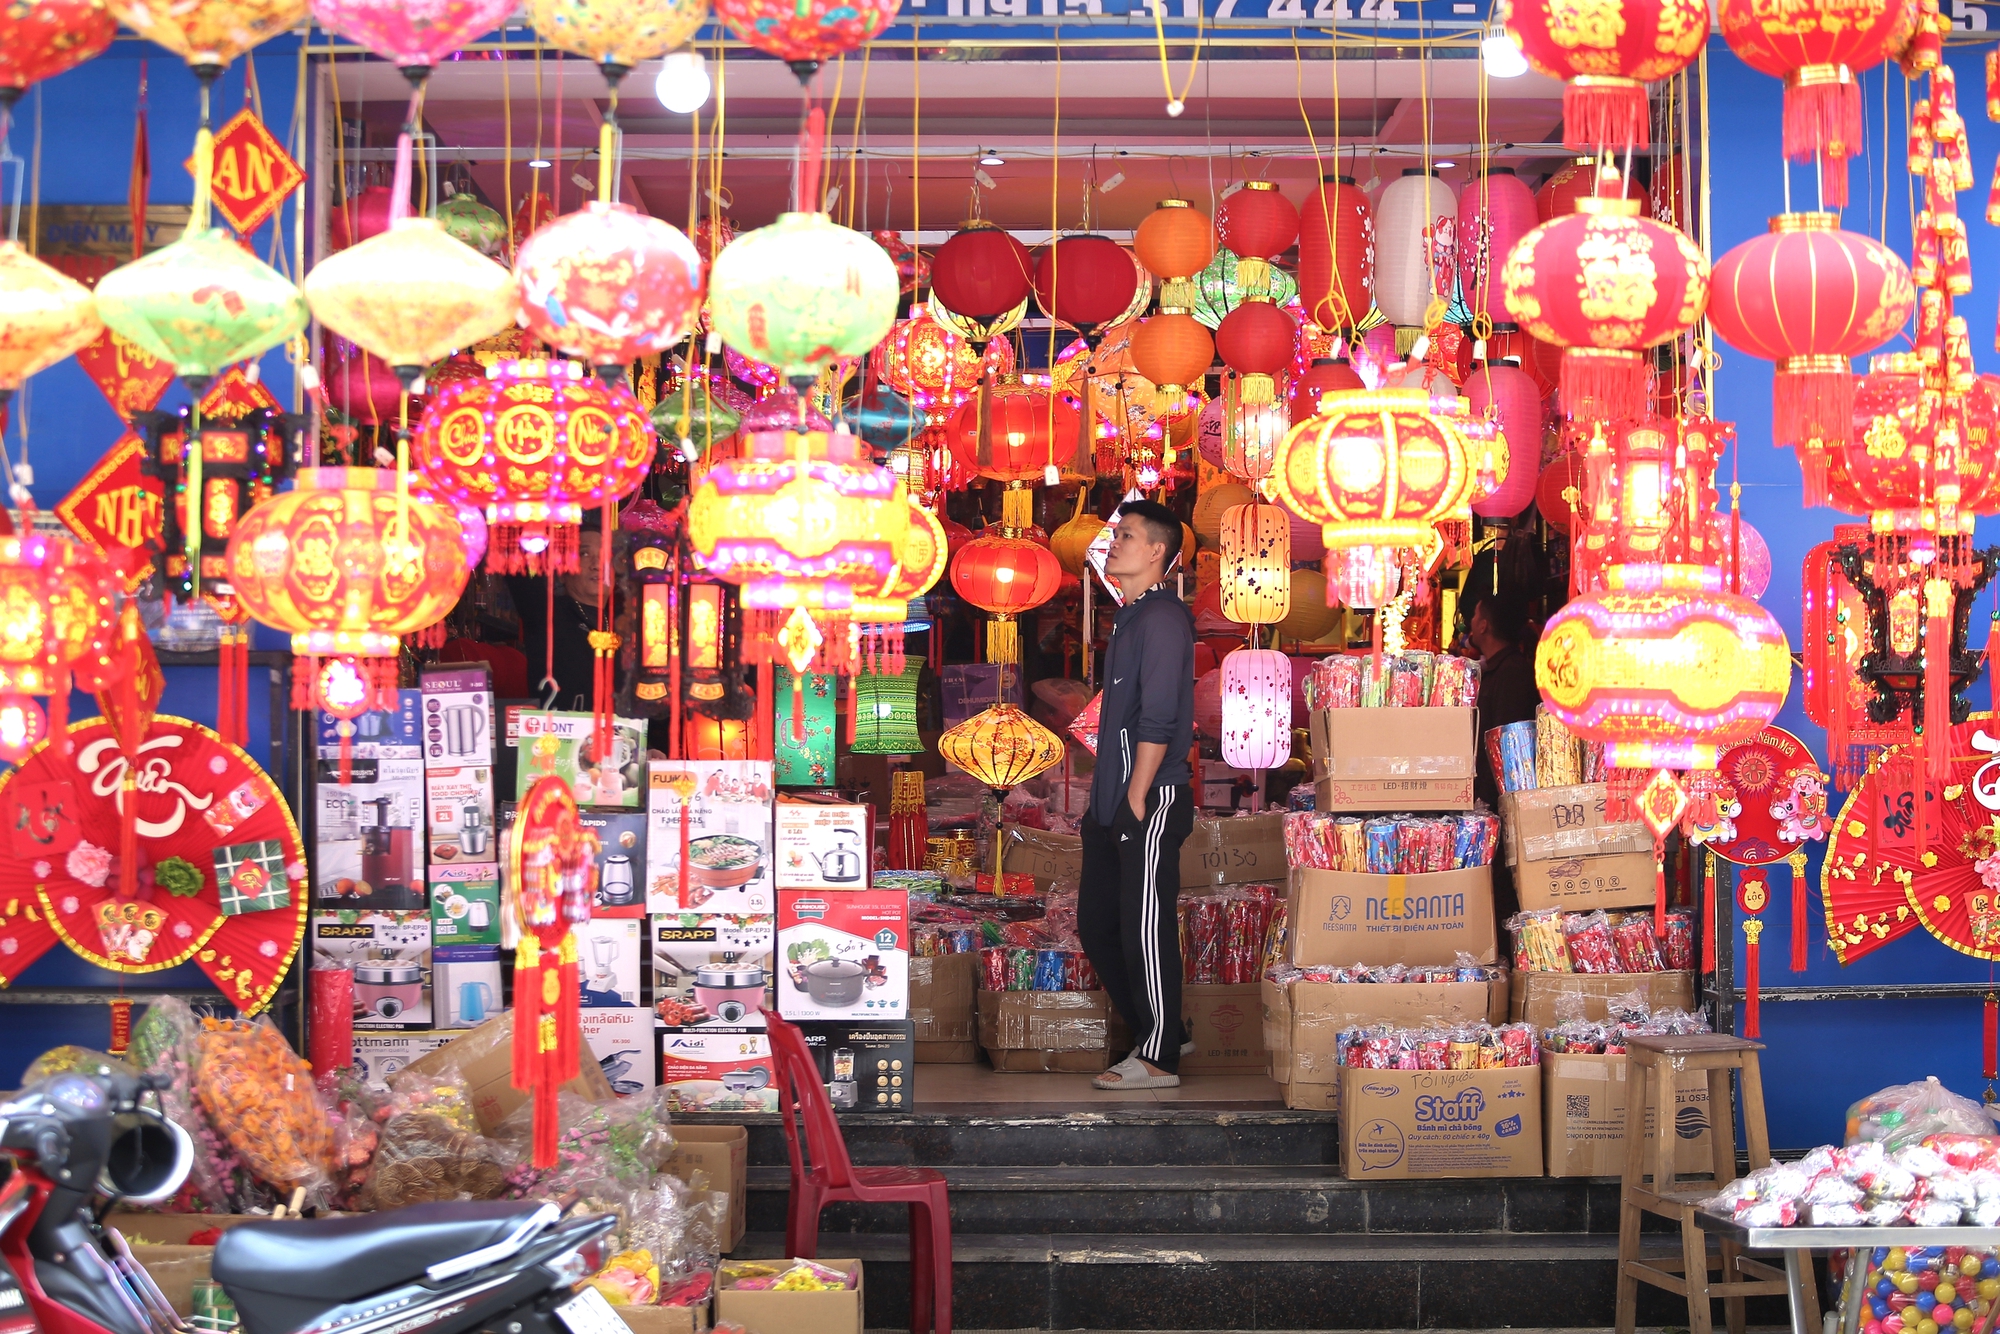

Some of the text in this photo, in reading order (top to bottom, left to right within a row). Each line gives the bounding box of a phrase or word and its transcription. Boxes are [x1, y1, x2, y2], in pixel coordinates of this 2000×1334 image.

[212, 141, 275, 201] AN
[425, 680, 461, 689] SEOUL
[1757, 731, 1797, 757] Năm Mới
[439, 812, 451, 821] 2L
[1747, 890, 1764, 902] LỘC
[1366, 893, 1464, 920] NEESANTA
[320, 927, 373, 937] SRAPP
[1323, 922, 1357, 932] NEESANTA
[1366, 921, 1464, 934] THIẾT BỊ ĐIỆN AN TOÀN
[660, 929, 715, 940] SRAPP
[879, 932, 892, 943] 12
[386, 1046, 409, 1054] quality
[1415, 1094, 1480, 1122] Staff
[1417, 1123, 1436, 1132] Bánh
[1438, 1123, 1447, 1132] mì
[1408, 1133, 1420, 1141] Quy
[1422, 1132, 1441, 1140] cách:
[1452, 1132, 1469, 1140] chiếc
[1477, 1132, 1490, 1141] 40g
